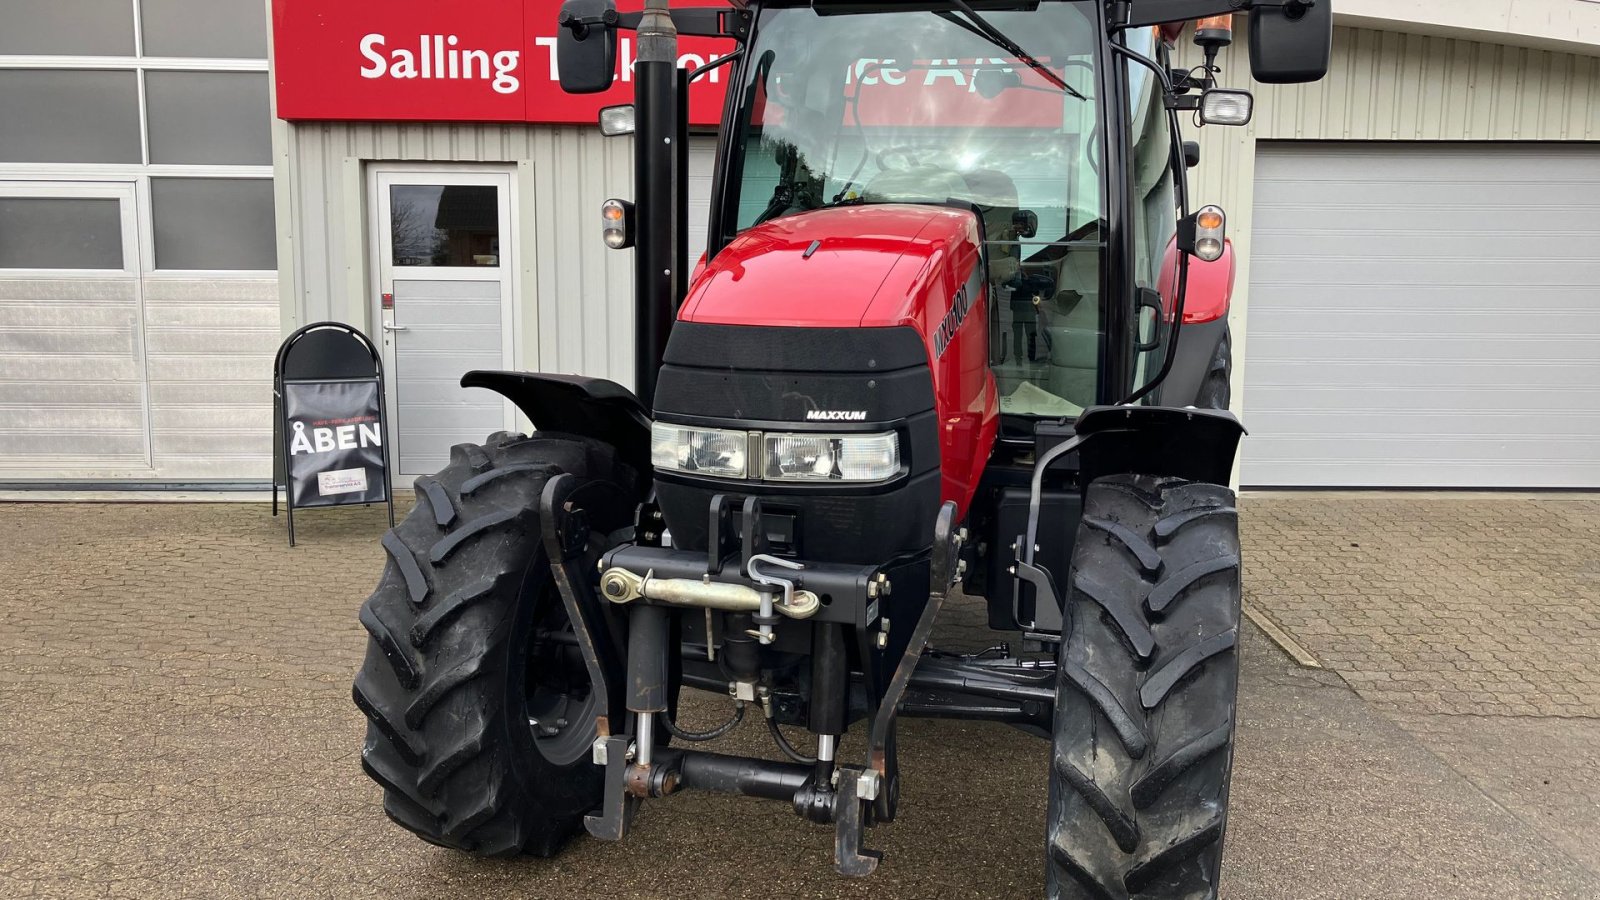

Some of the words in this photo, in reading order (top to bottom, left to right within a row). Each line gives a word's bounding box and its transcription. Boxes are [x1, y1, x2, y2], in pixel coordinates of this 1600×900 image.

[359, 33, 520, 94] Salling
[806, 409, 868, 421] MAXXUM
[290, 421, 381, 456] ÅBEN
